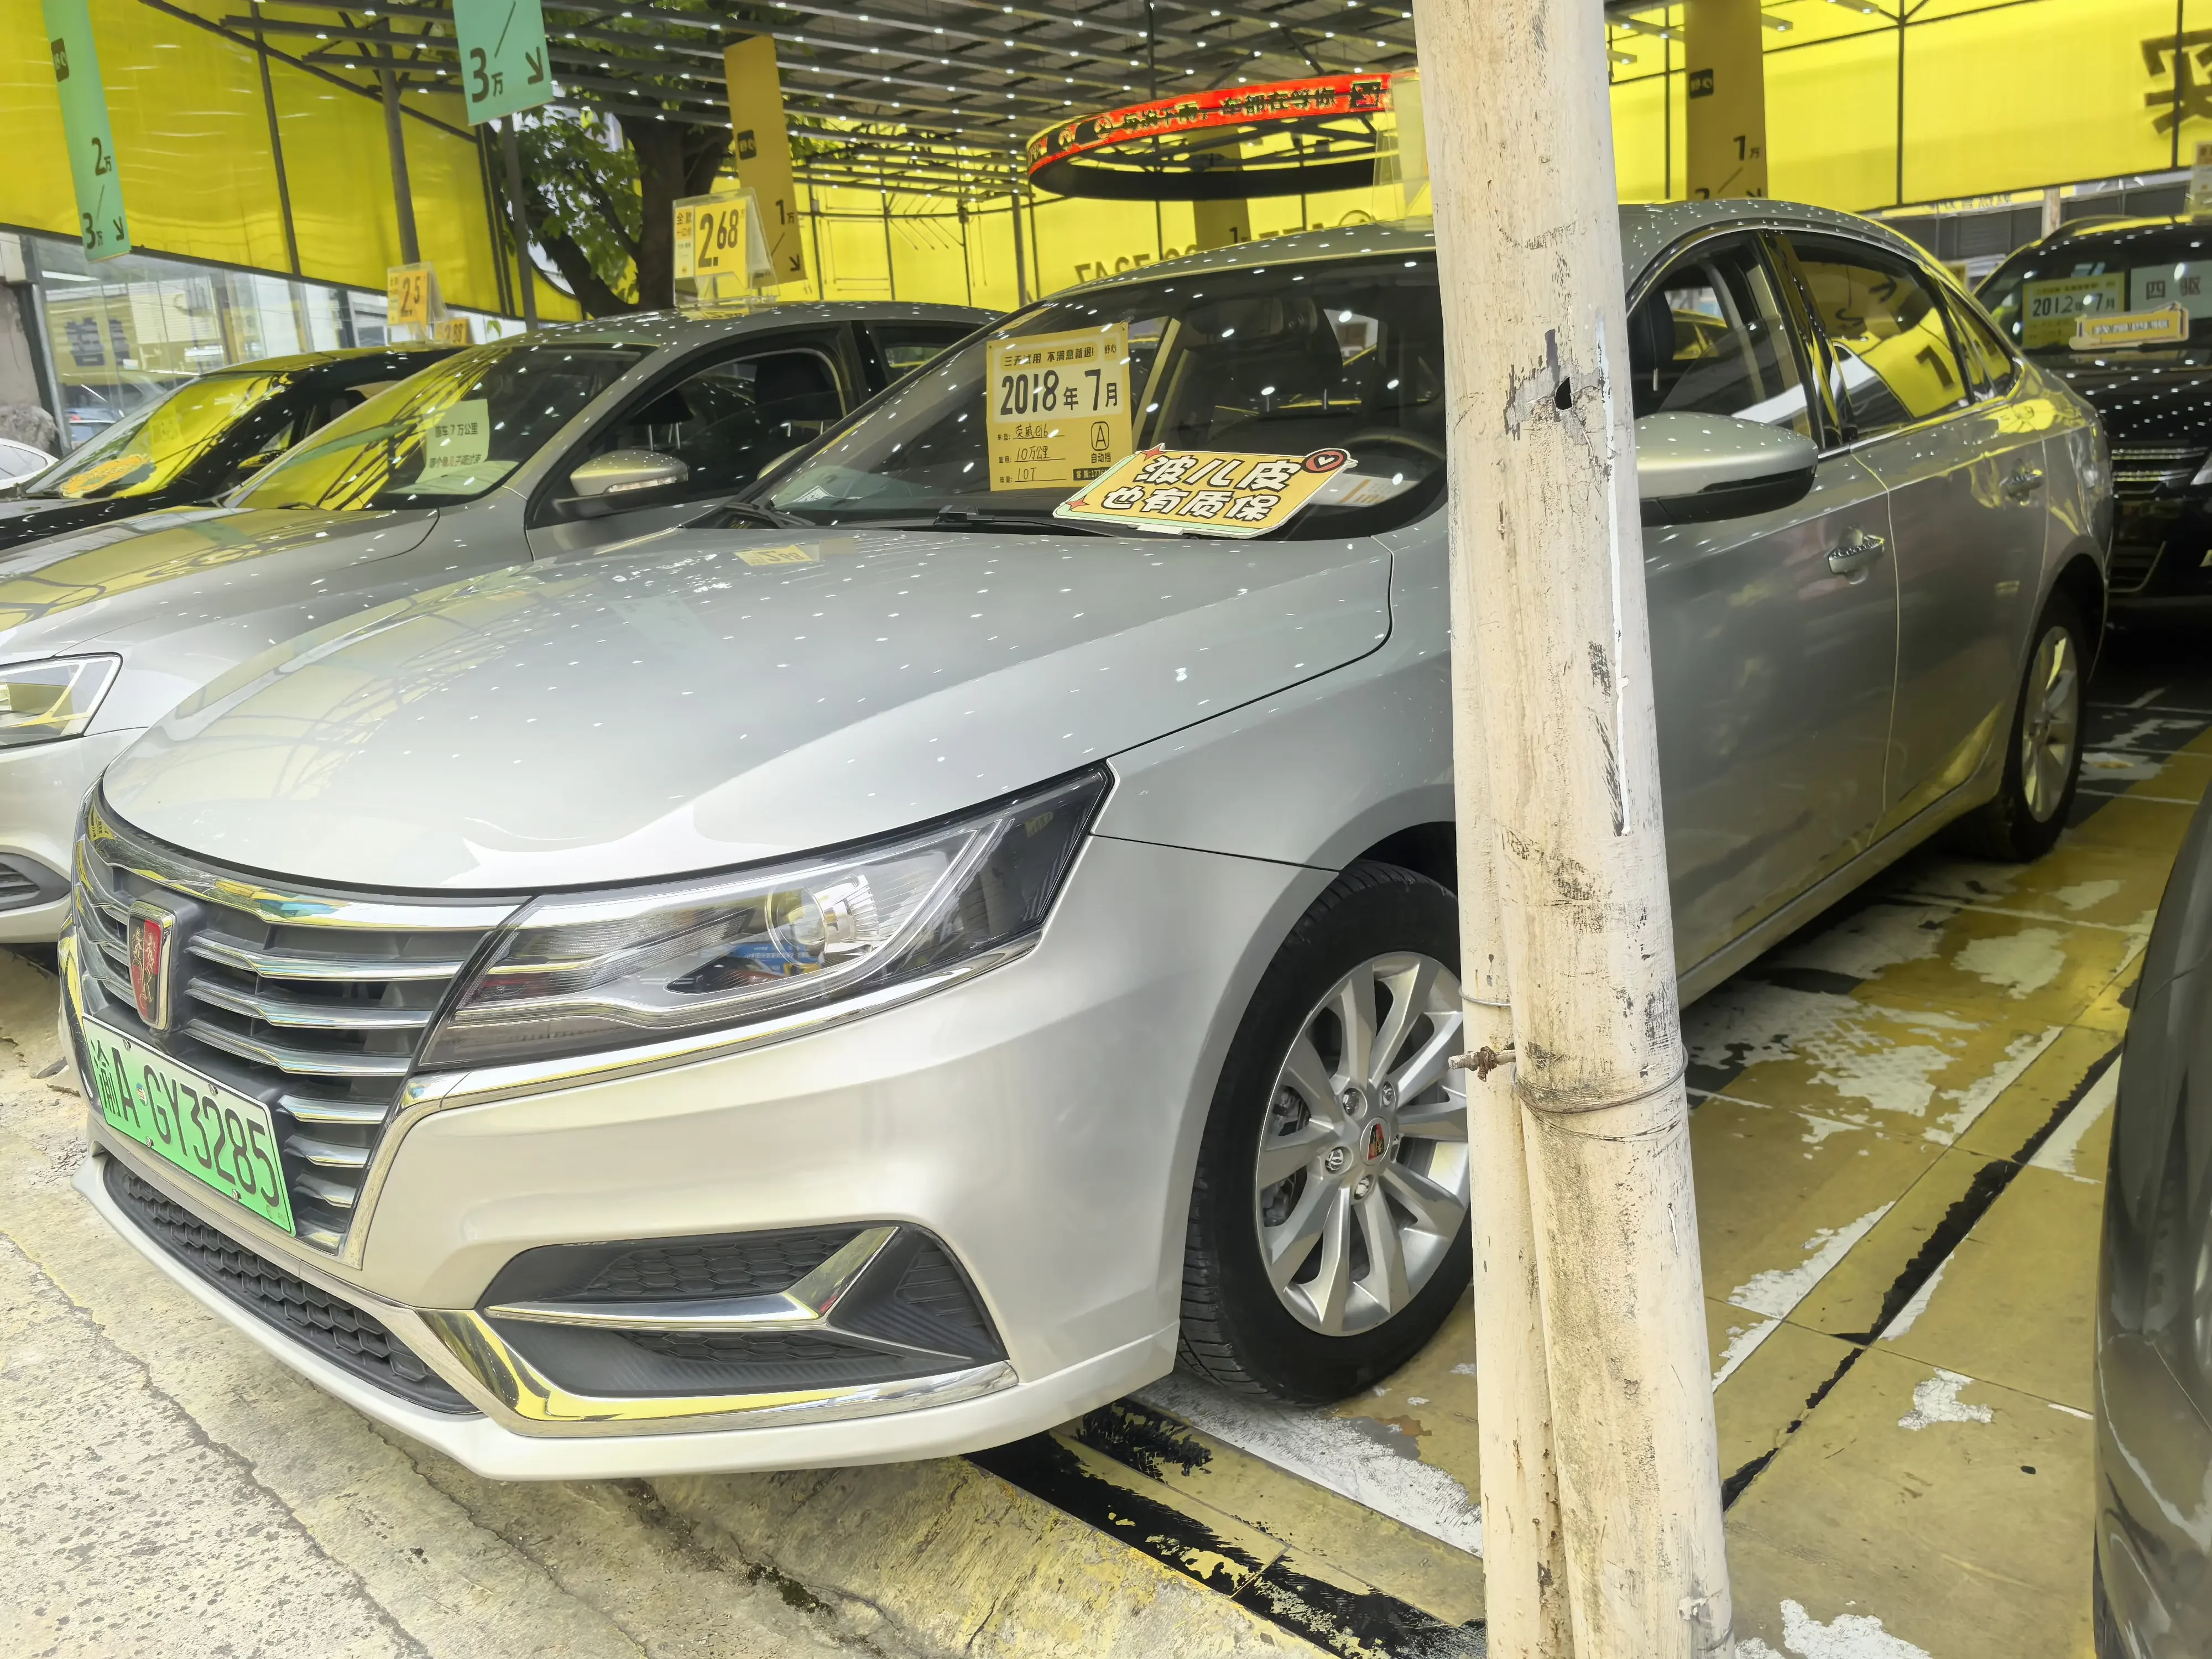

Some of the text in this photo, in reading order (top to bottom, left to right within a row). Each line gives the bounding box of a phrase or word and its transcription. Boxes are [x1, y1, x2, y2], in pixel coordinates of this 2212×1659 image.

[470, 47, 503, 103] 3万
[92, 137, 112, 176] 2万
[1733, 135, 1761, 161] 1万
[776, 199, 795, 225] 1万
[82, 212, 103, 249] 3万
[1004, 353, 1041, 367] 三天试用
[1047, 347, 1094, 362] 不满意就退!
[1095, 425, 1107, 447] A
[1016, 446, 1051, 461] 10万公里
[1133, 455, 1301, 493] 波儿皮
[1100, 486, 1281, 521] 也有质保
